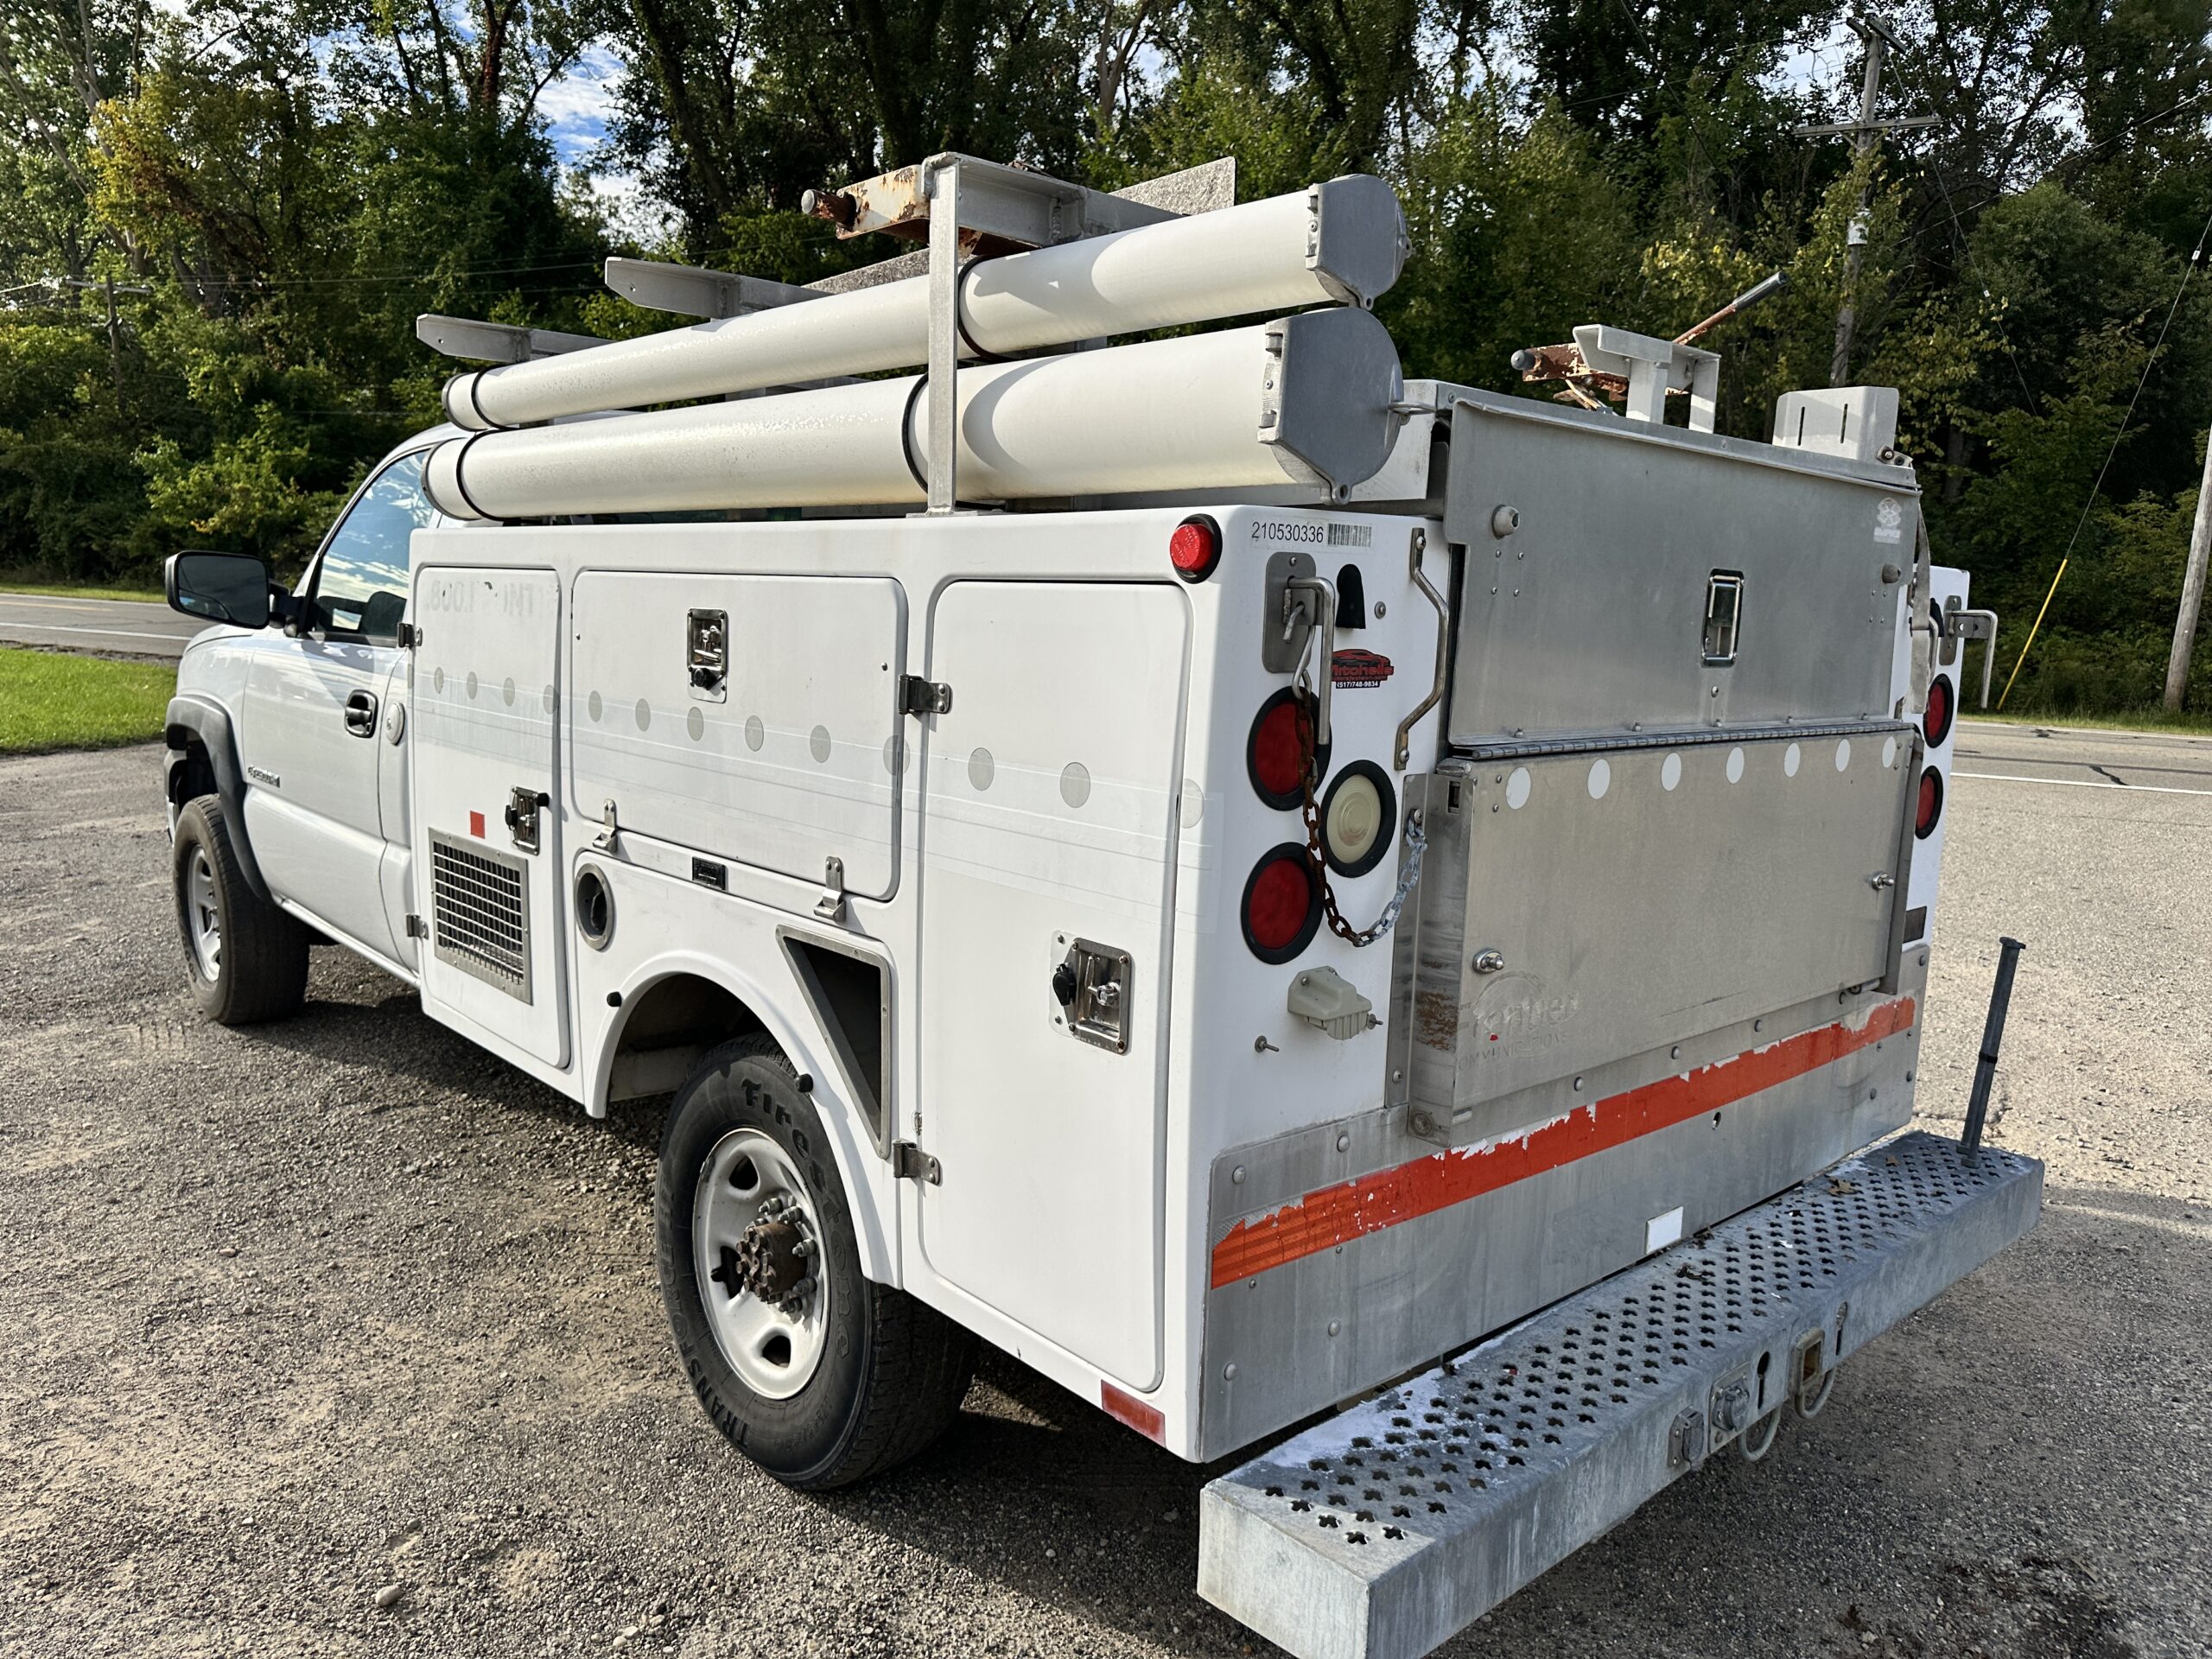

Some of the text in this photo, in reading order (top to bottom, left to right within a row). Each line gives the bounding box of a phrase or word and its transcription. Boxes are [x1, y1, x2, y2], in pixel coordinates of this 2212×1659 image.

[1250, 521, 1324, 543] 210530336
[1337, 680, 1379, 689] (517)748-9834
[740, 1077, 853, 1361] Firestone
[659, 1243, 751, 1450] TRANSFORCE
